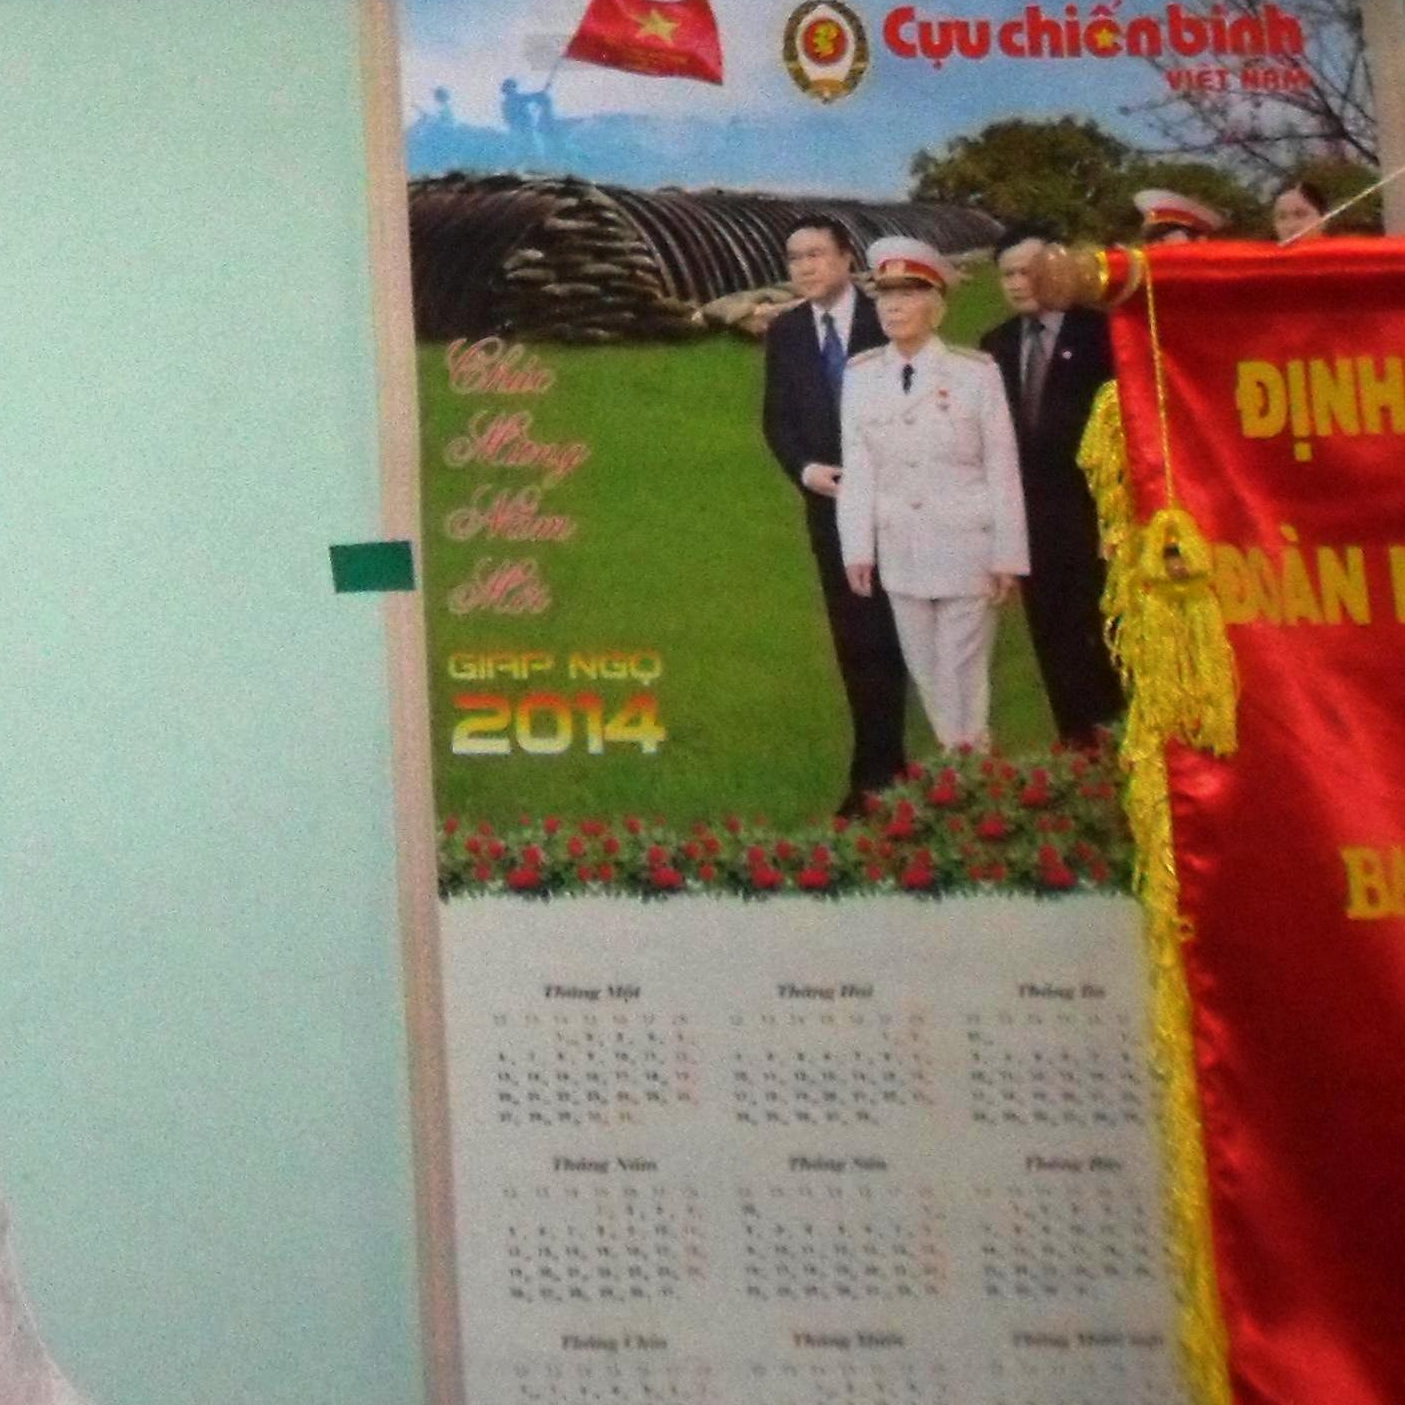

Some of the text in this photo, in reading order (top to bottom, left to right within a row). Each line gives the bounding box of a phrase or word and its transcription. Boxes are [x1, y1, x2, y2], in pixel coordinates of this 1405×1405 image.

[882, 4, 991, 70] Cựu
[1165, 2, 1306, 59] binh
[569, 649, 663, 686] NGỌ
[451, 692, 668, 755] 2014
